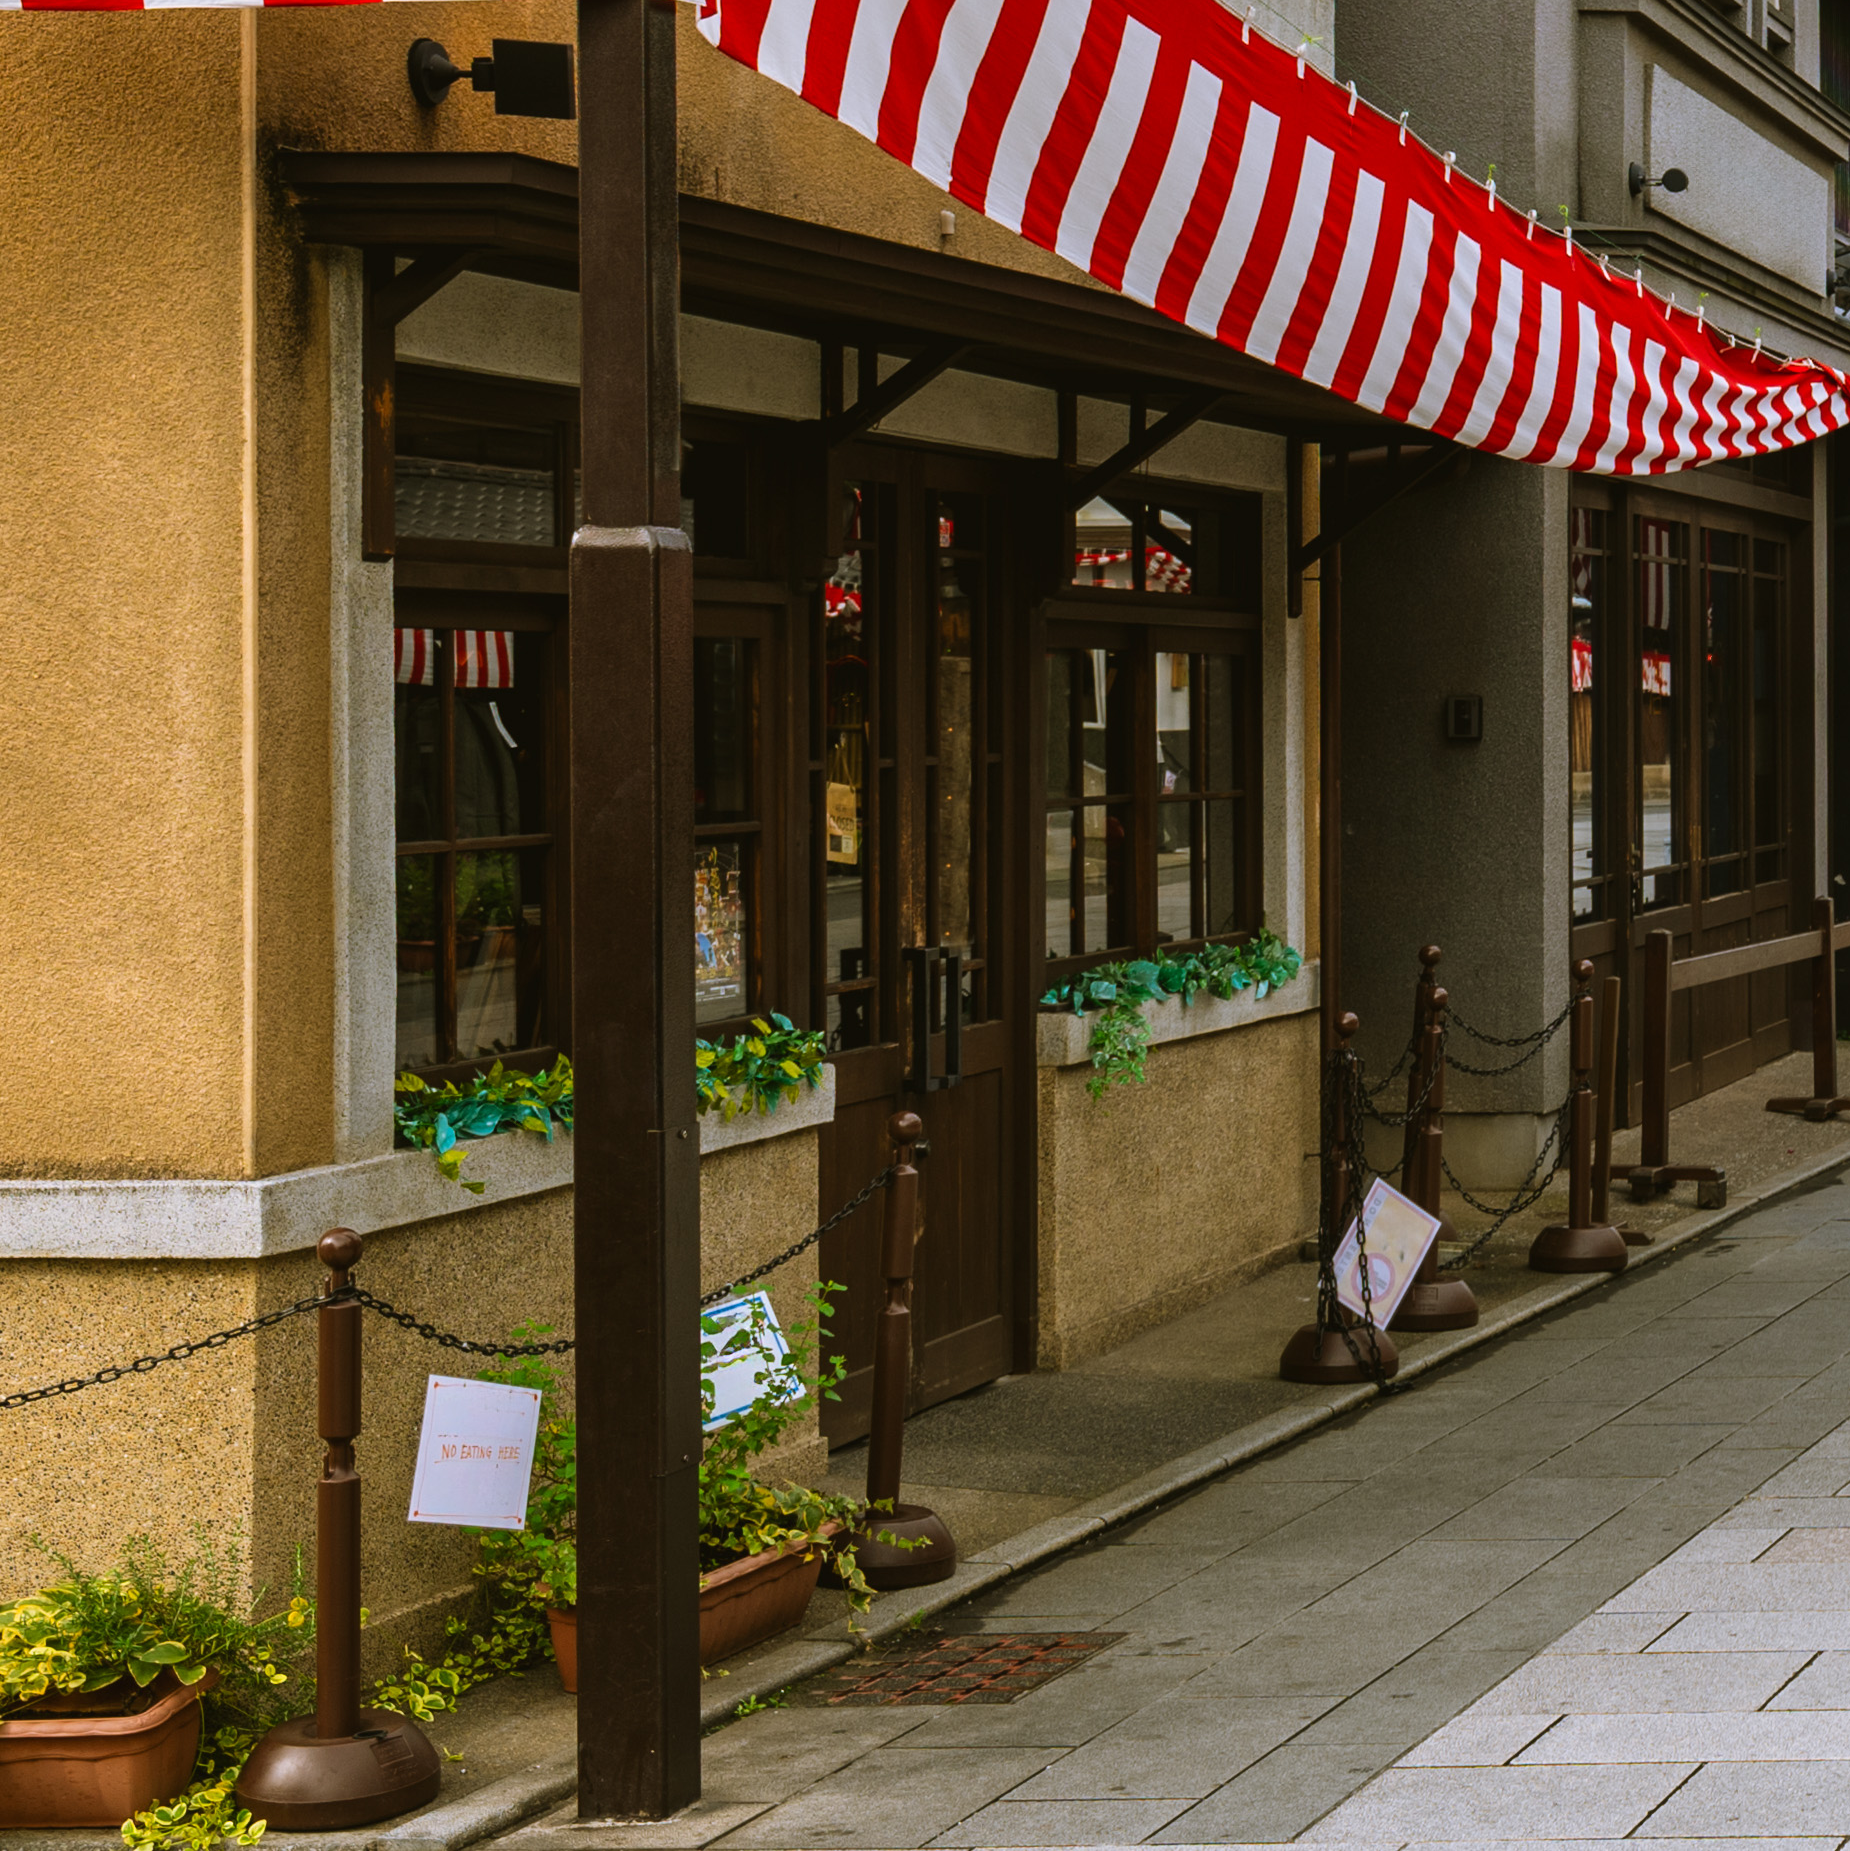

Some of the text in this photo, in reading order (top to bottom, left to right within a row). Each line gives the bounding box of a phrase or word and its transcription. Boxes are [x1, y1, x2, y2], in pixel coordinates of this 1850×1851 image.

[441, 1443, 521, 1460] NO EATING HERE
